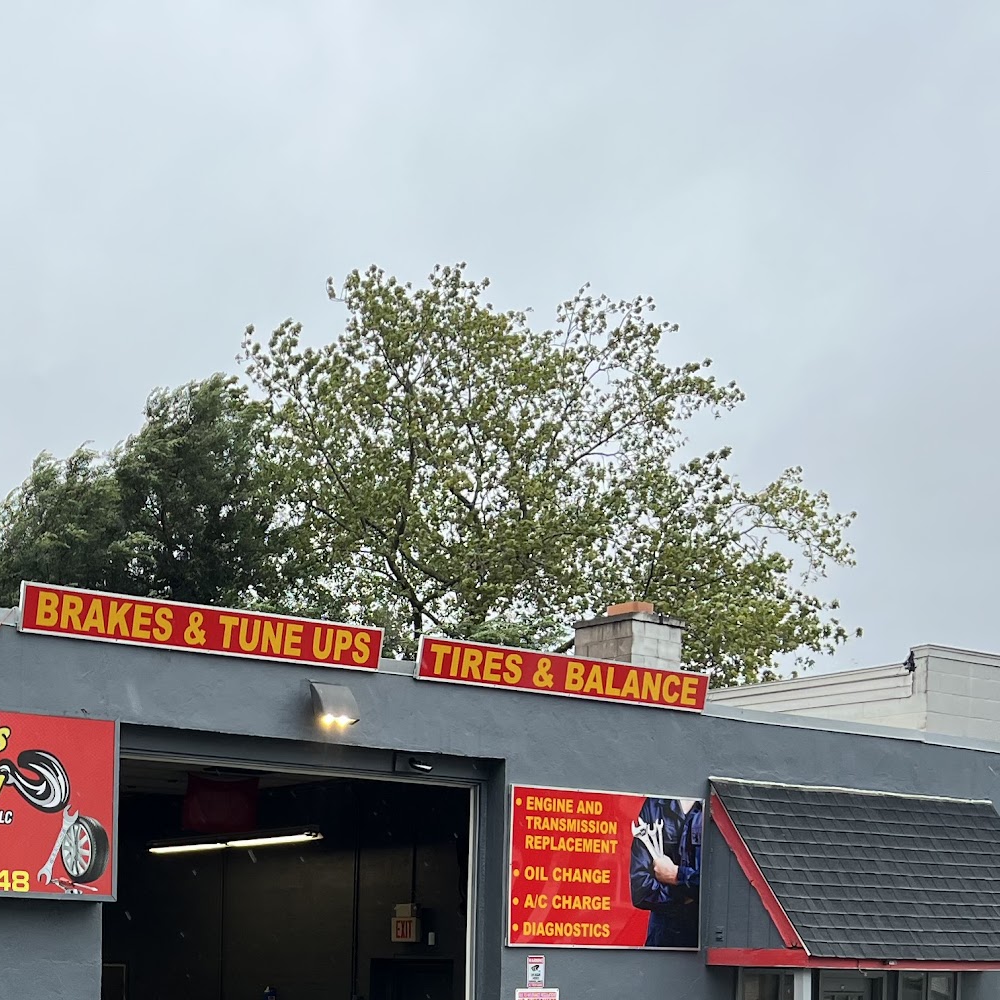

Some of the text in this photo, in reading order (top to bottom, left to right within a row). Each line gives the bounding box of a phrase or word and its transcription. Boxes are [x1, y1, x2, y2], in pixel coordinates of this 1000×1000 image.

[35, 590, 371, 664] BRAKES & TUNE UPS
[430, 643, 699, 706] TIRES & BALANCE
[526, 796, 603, 815] ENGINE AND
[526, 815, 617, 835] TRANSMISSION
[525, 835, 618, 854] REPLACEMENT
[524, 866, 610, 884] OIL CHANGE
[524, 894, 611, 910] A/C CHARGE
[396, 920, 412, 938] EXIT
[522, 921, 610, 938] DIAGNOSTICS
